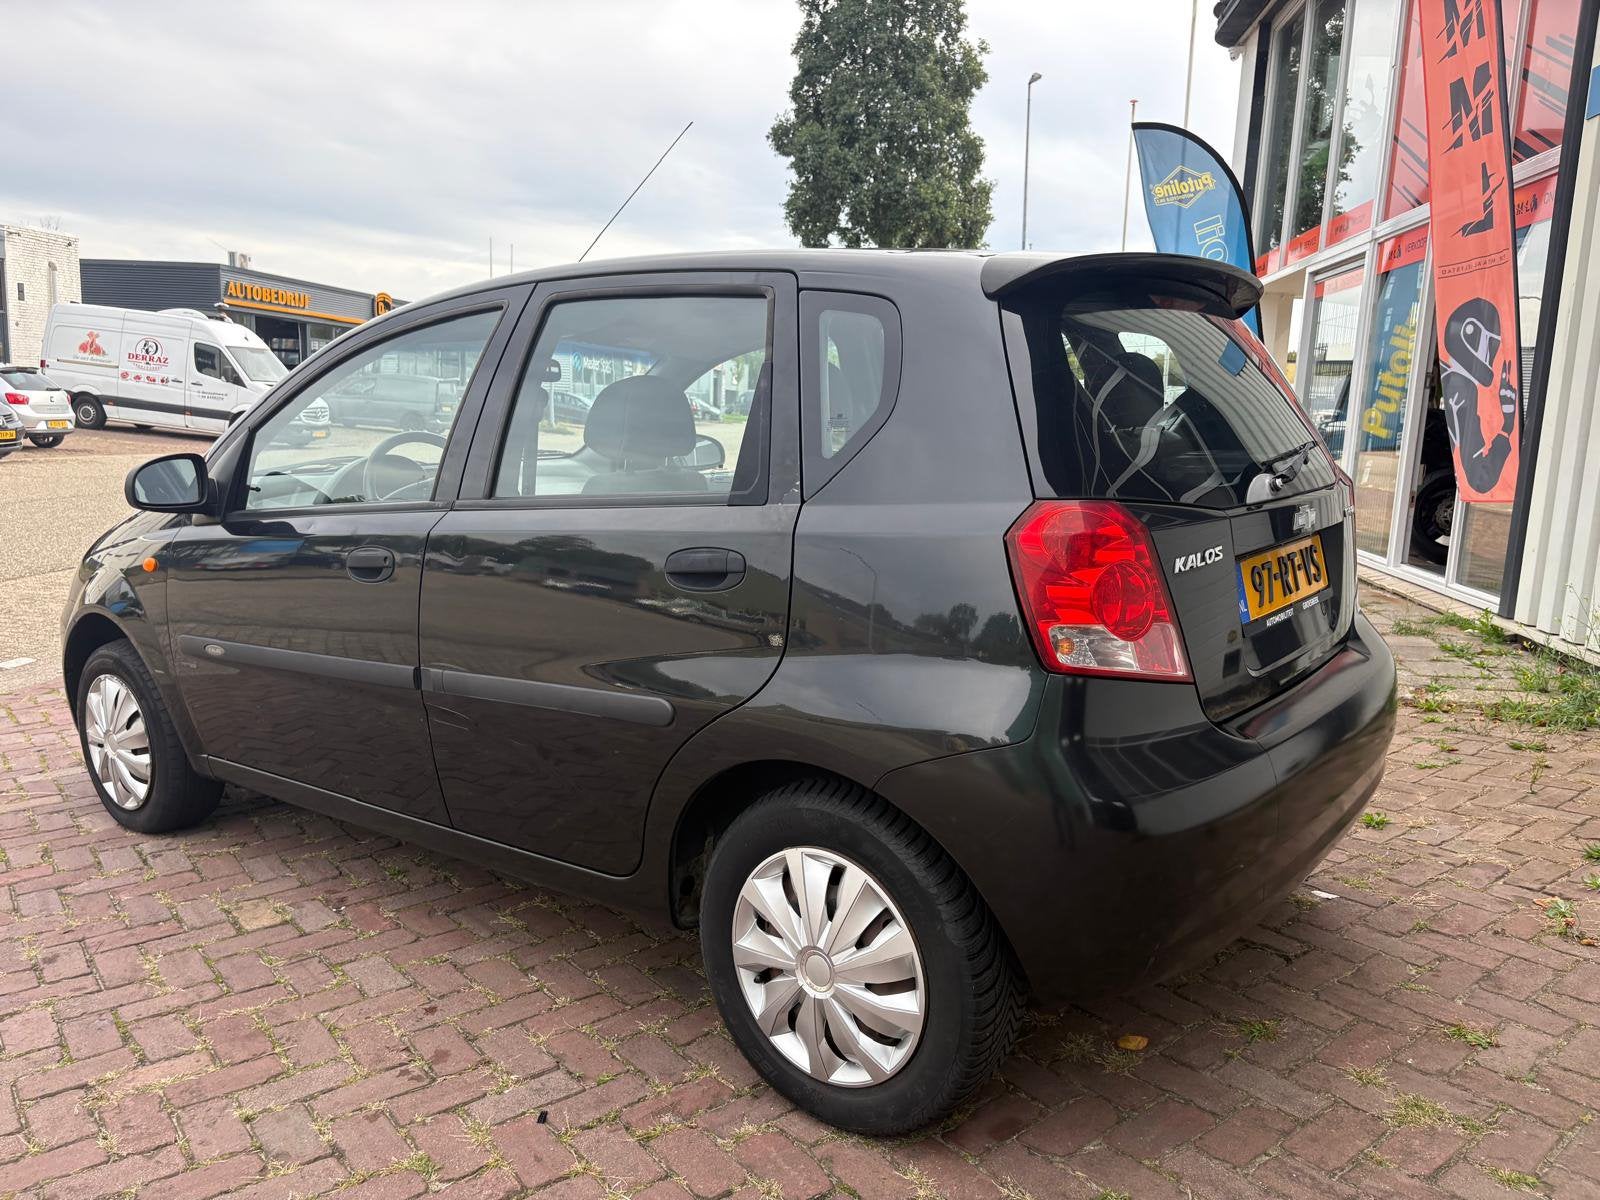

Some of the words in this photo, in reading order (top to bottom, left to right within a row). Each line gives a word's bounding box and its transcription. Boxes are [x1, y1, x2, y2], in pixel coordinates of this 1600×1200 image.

[227, 280, 312, 308] AUTOBEDRIJF
[127, 353, 169, 365] DERRAZ
[1174, 545, 1224, 574] KALOS
[1251, 544, 1322, 608] 97-RT-VS
[1239, 600, 1248, 614] NL
